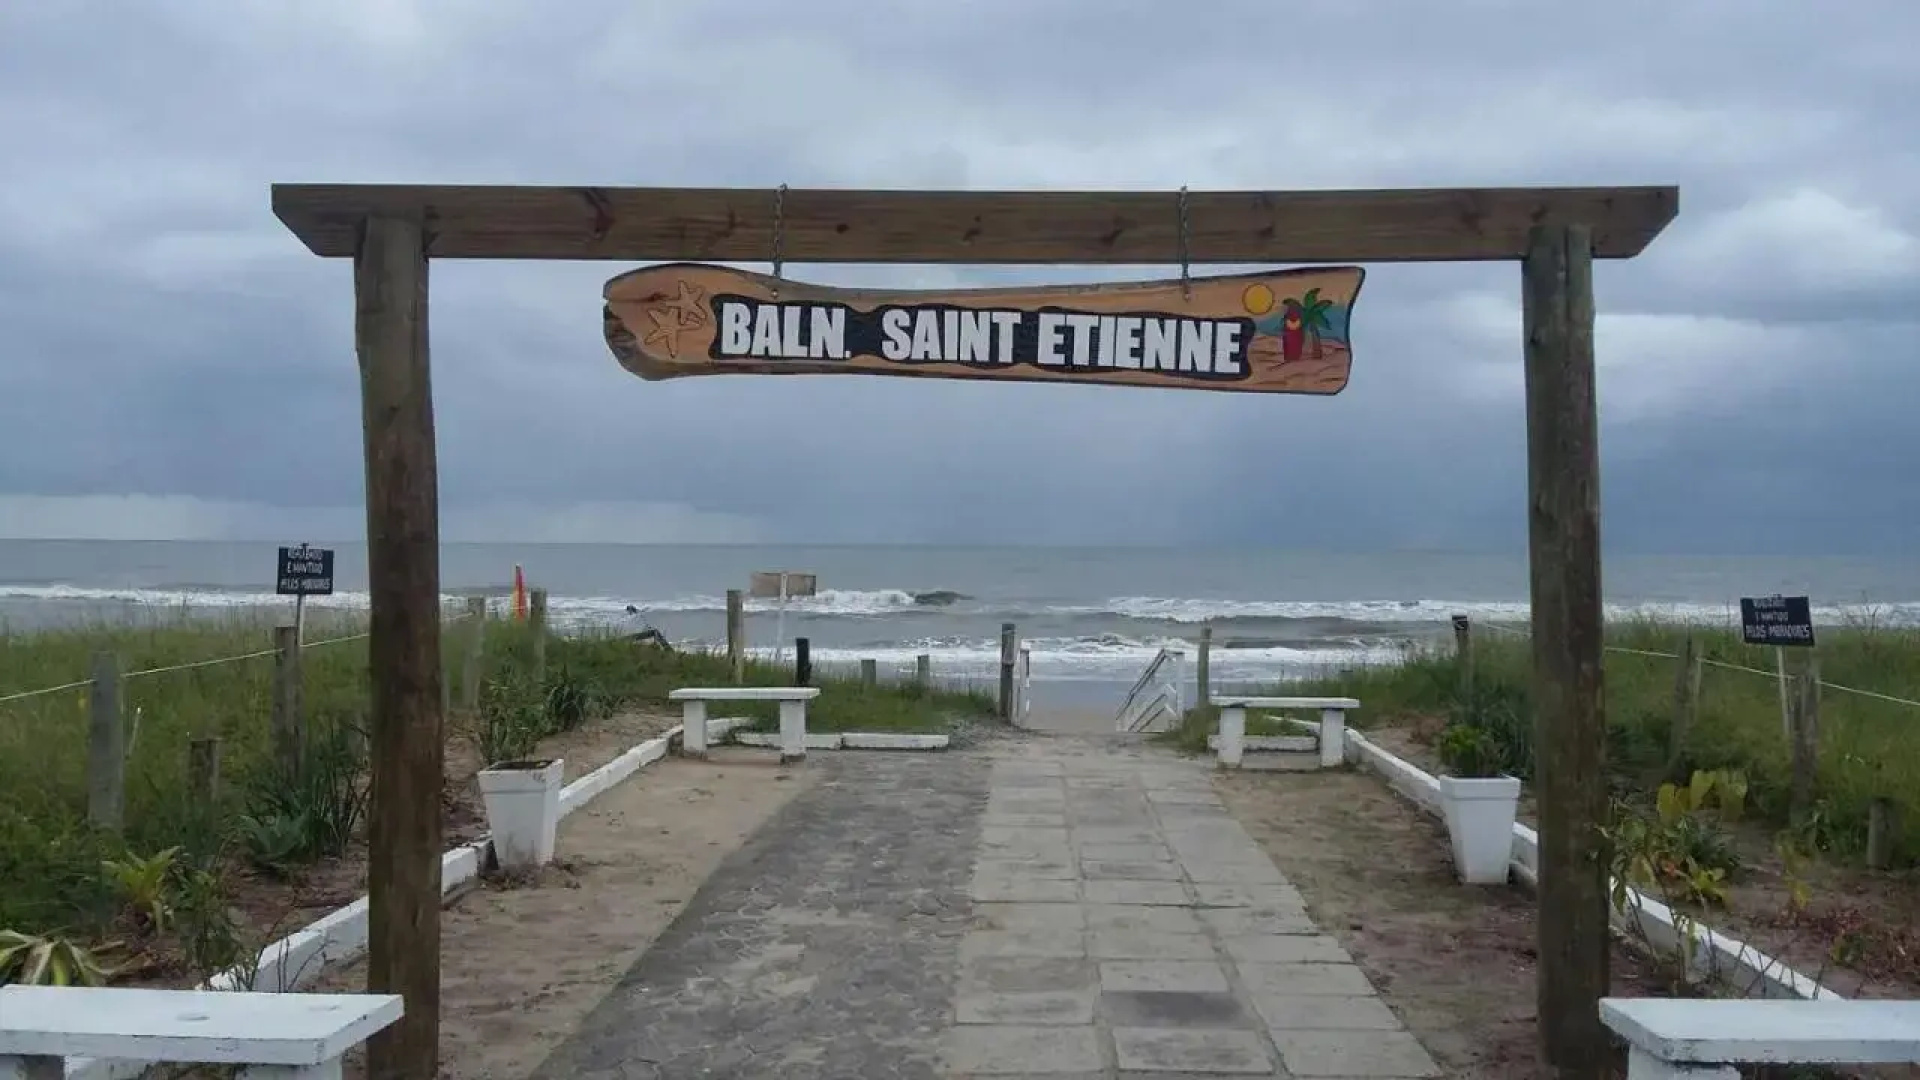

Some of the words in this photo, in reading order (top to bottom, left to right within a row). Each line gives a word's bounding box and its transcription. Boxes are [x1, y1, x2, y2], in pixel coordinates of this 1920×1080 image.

[721, 303, 850, 359] BALN.
[881, 307, 1021, 363] SAINT
[1037, 313, 1241, 374] ETIENNE
